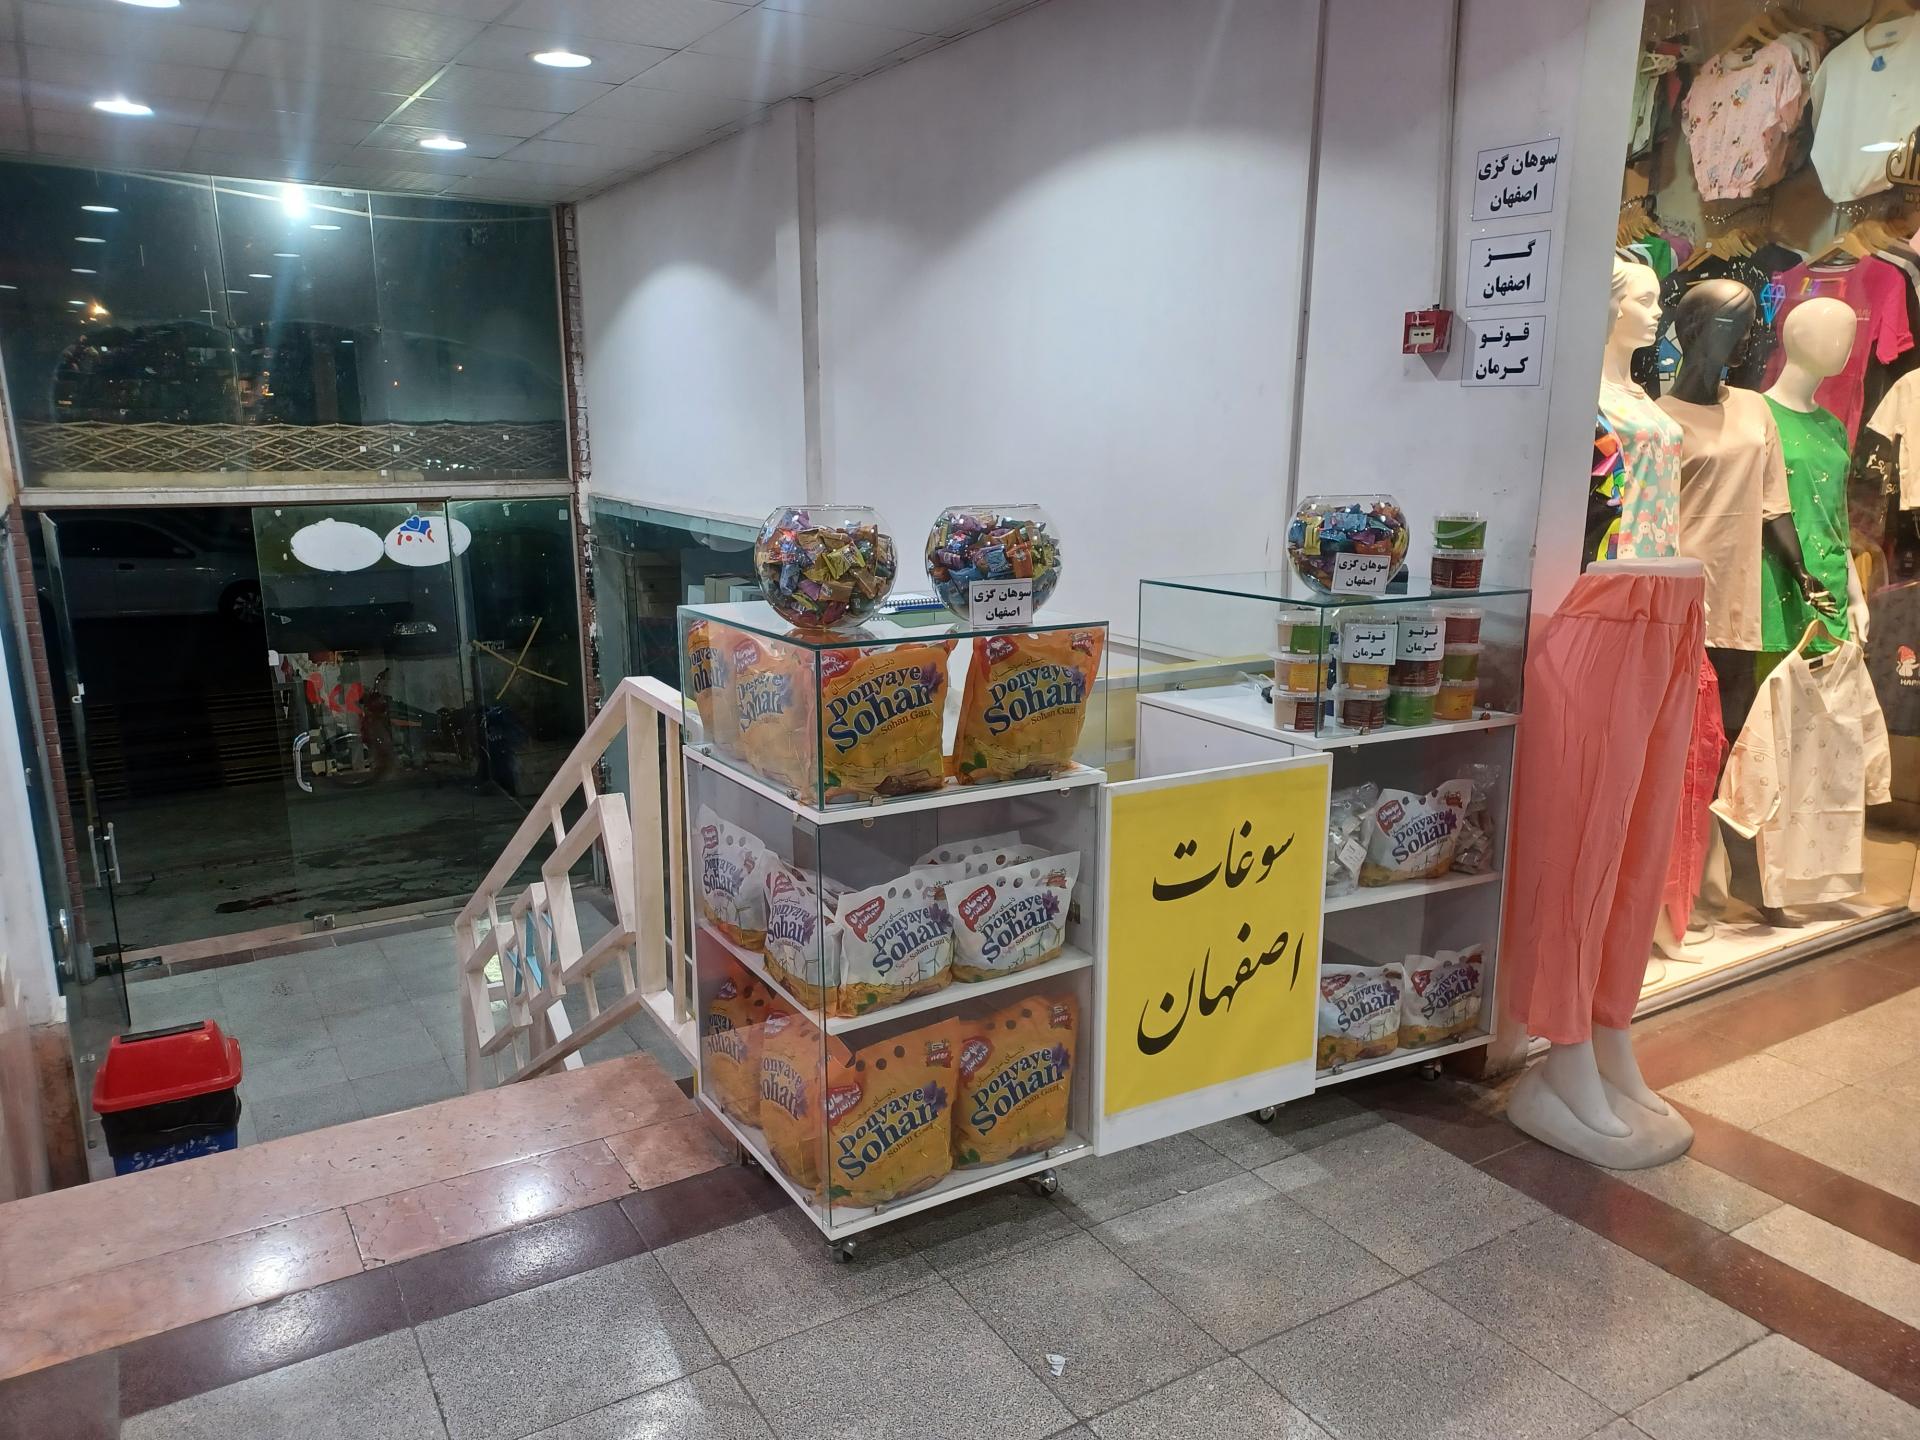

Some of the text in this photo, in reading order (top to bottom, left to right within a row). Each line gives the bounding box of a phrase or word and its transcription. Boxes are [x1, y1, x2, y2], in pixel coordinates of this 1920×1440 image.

[1478, 151, 1557, 180] سوهان گزی
[1490, 183, 1538, 211] اصفهان
[1483, 273, 1531, 298] اصفهان
[1479, 323, 1530, 349] قوتو
[1475, 356, 1528, 380] کرمان
[1346, 575, 1376, 587] اصفهان
[1360, 560, 1388, 572] سوهان
[999, 587, 1032, 601] سوهان
[985, 606, 1020, 621] اصفهان
[1355, 630, 1386, 643] قوتو
[828, 685, 933, 754] Sohan
[984, 682, 1081, 736] Sohan
[1392, 822, 1452, 865] Sohan
[1152, 820, 1295, 902] سوغات
[768, 915, 805, 946] Sohan
[982, 906, 1054, 964] Sohan
[872, 920, 948, 977] Sohan
[1137, 922, 1304, 1056] اصفهان
[1338, 994, 1396, 1032] Sohan
[971, 1063, 1064, 1136] Sohan
[838, 1103, 939, 1181] Sohan
